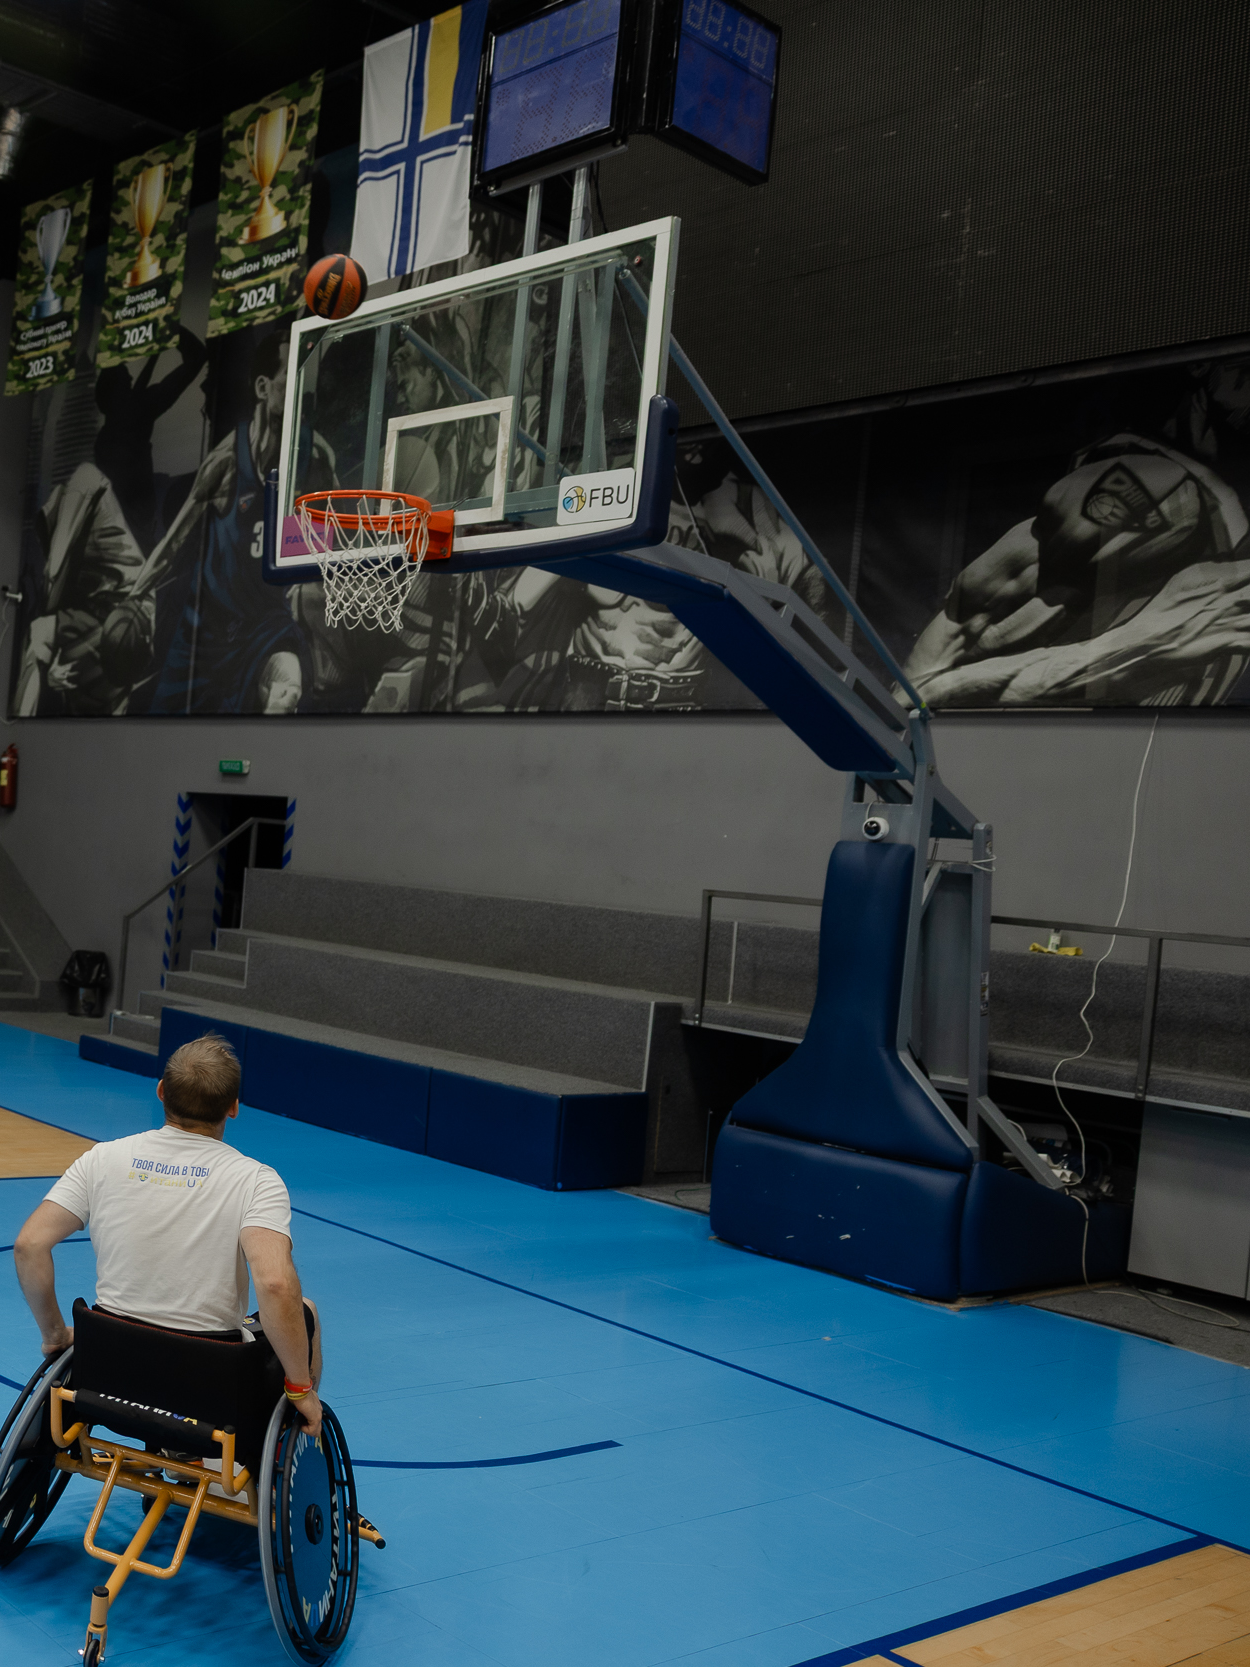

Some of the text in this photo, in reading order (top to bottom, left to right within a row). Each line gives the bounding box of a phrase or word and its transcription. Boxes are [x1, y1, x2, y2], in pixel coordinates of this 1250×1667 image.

[237, 283, 276, 314] 2024
[121, 322, 153, 349] 2024
[25, 355, 54, 379] 2023
[588, 484, 629, 508] FBU
[131, 1157, 210, 1178] ТВОЯ СИЛА В ТОБІ
